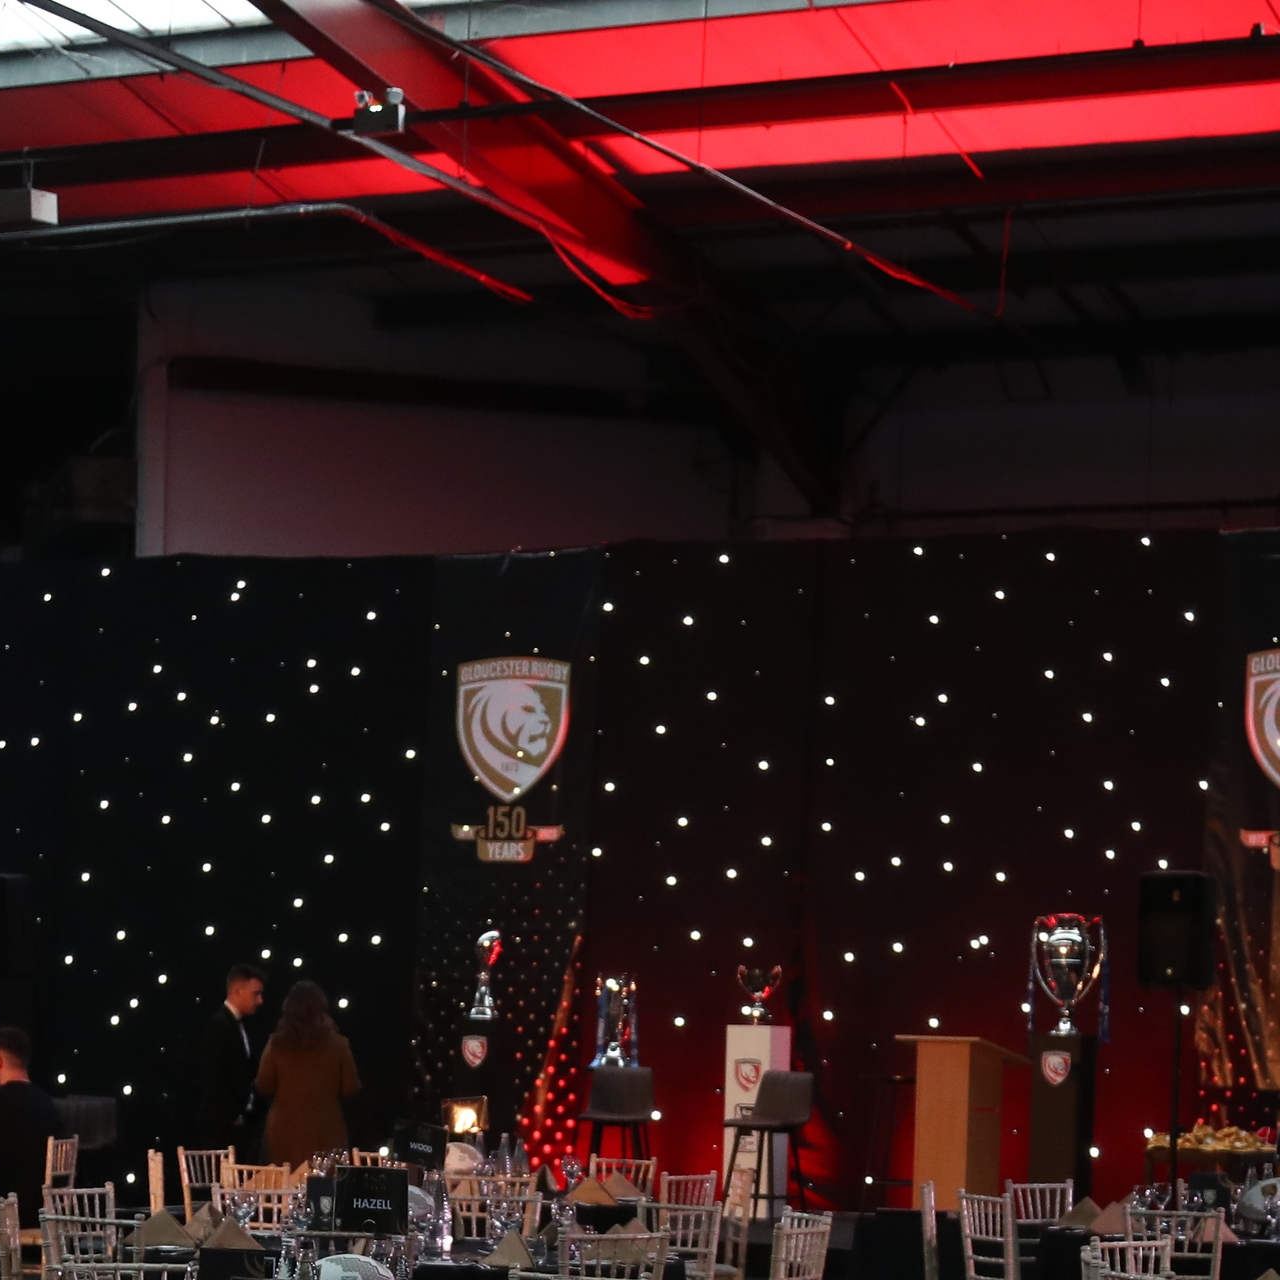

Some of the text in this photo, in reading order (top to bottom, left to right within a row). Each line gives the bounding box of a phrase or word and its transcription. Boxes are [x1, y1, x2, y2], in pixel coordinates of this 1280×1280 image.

[461, 660, 569, 682] GLOUCESTER RUGBY
[487, 805, 527, 839] 150
[487, 842, 525, 860] YEARS
[409, 1142, 432, 1153] WOOD
[353, 1197, 392, 1210] HAZELL
